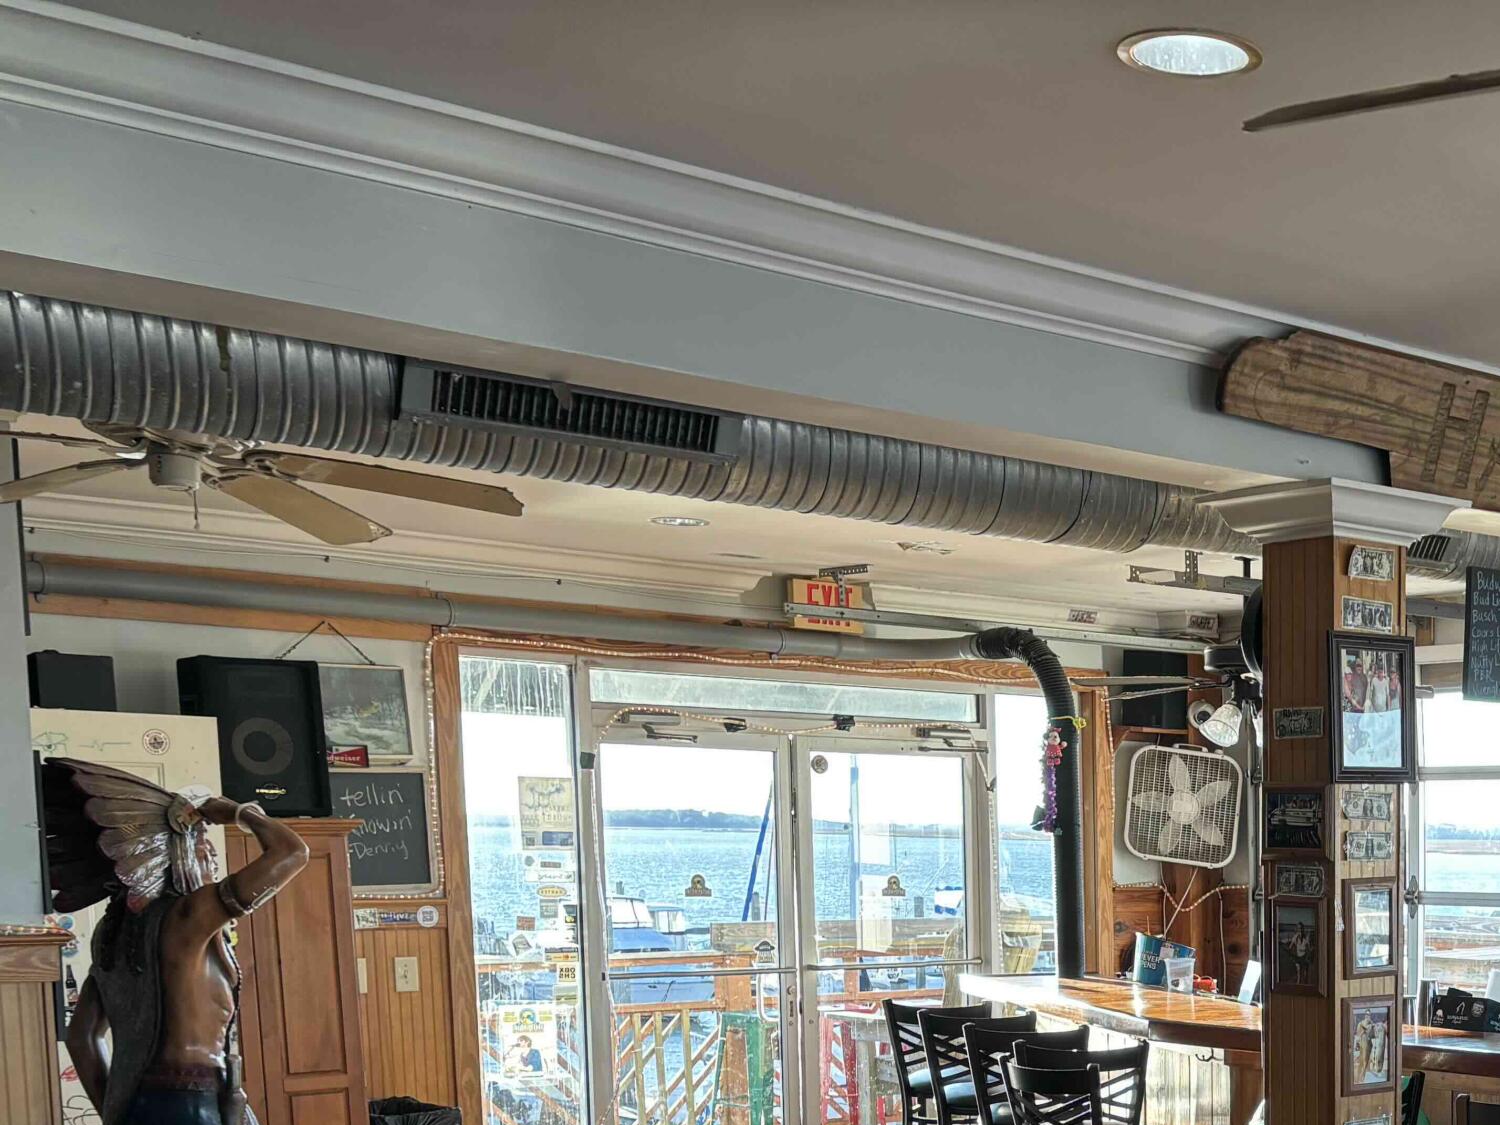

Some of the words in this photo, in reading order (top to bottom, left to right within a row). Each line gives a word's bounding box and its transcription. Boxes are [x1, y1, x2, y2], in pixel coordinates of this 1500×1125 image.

[1473, 592, 1490, 606] Bud
[1472, 609, 1498, 623] Busch
[328, 754, 361, 762] dweiser
